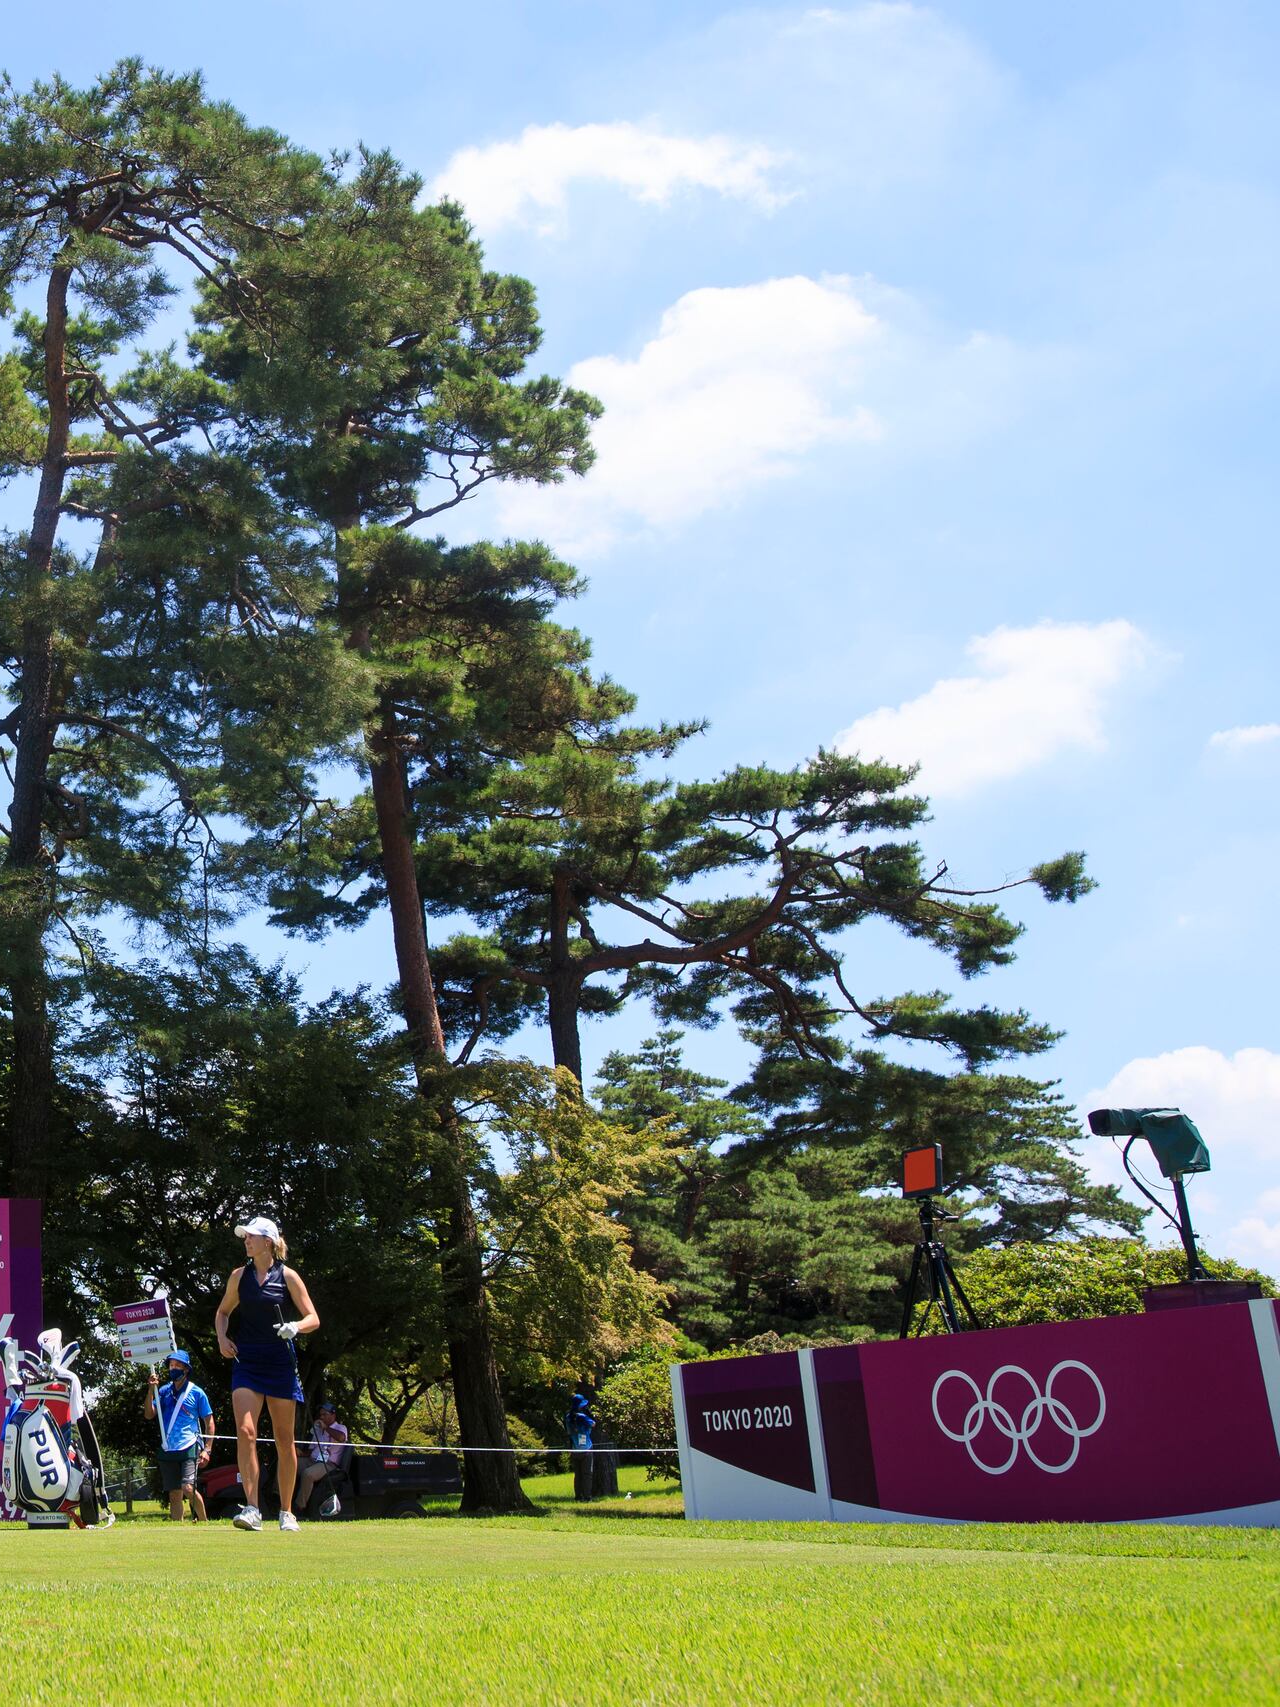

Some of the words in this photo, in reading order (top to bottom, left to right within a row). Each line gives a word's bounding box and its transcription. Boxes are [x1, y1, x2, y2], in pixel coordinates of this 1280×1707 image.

[125, 1310, 142, 1319] TOKYO
[142, 1307, 155, 1316] 2020
[702, 1408, 751, 1432] TOKYO
[754, 1405, 792, 1429] 2020
[28, 1429, 59, 1490] PUR
